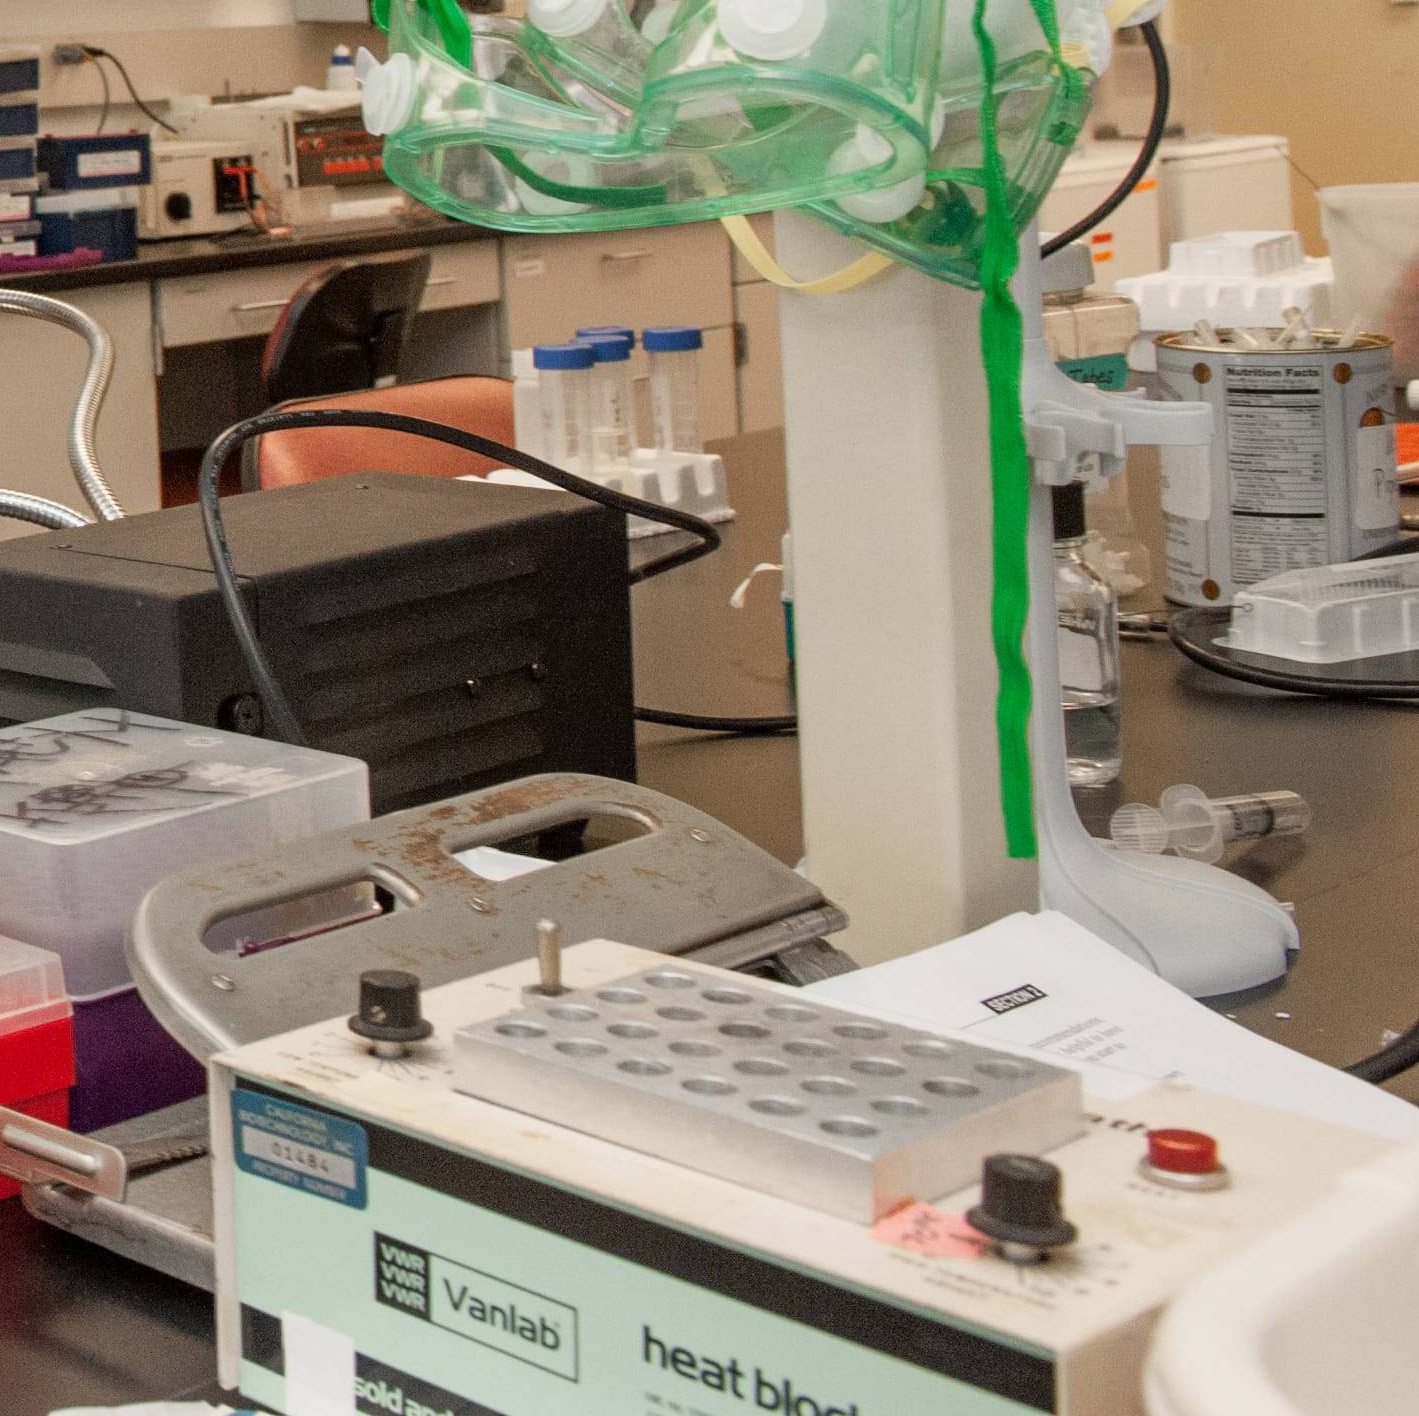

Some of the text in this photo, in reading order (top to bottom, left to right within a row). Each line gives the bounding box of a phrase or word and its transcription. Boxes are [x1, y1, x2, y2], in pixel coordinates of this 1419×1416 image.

[1226, 366, 1320, 377] Nutrition Facts
[988, 985, 1043, 1012] SECTION 2
[379, 1242, 426, 1274] VWR
[379, 1261, 426, 1293] VWR
[379, 1280, 427, 1313] VWR
[442, 1277, 561, 1351] Vanlab
[642, 1324, 746, 1400] heat
[753, 1366, 859, 1416] blo
